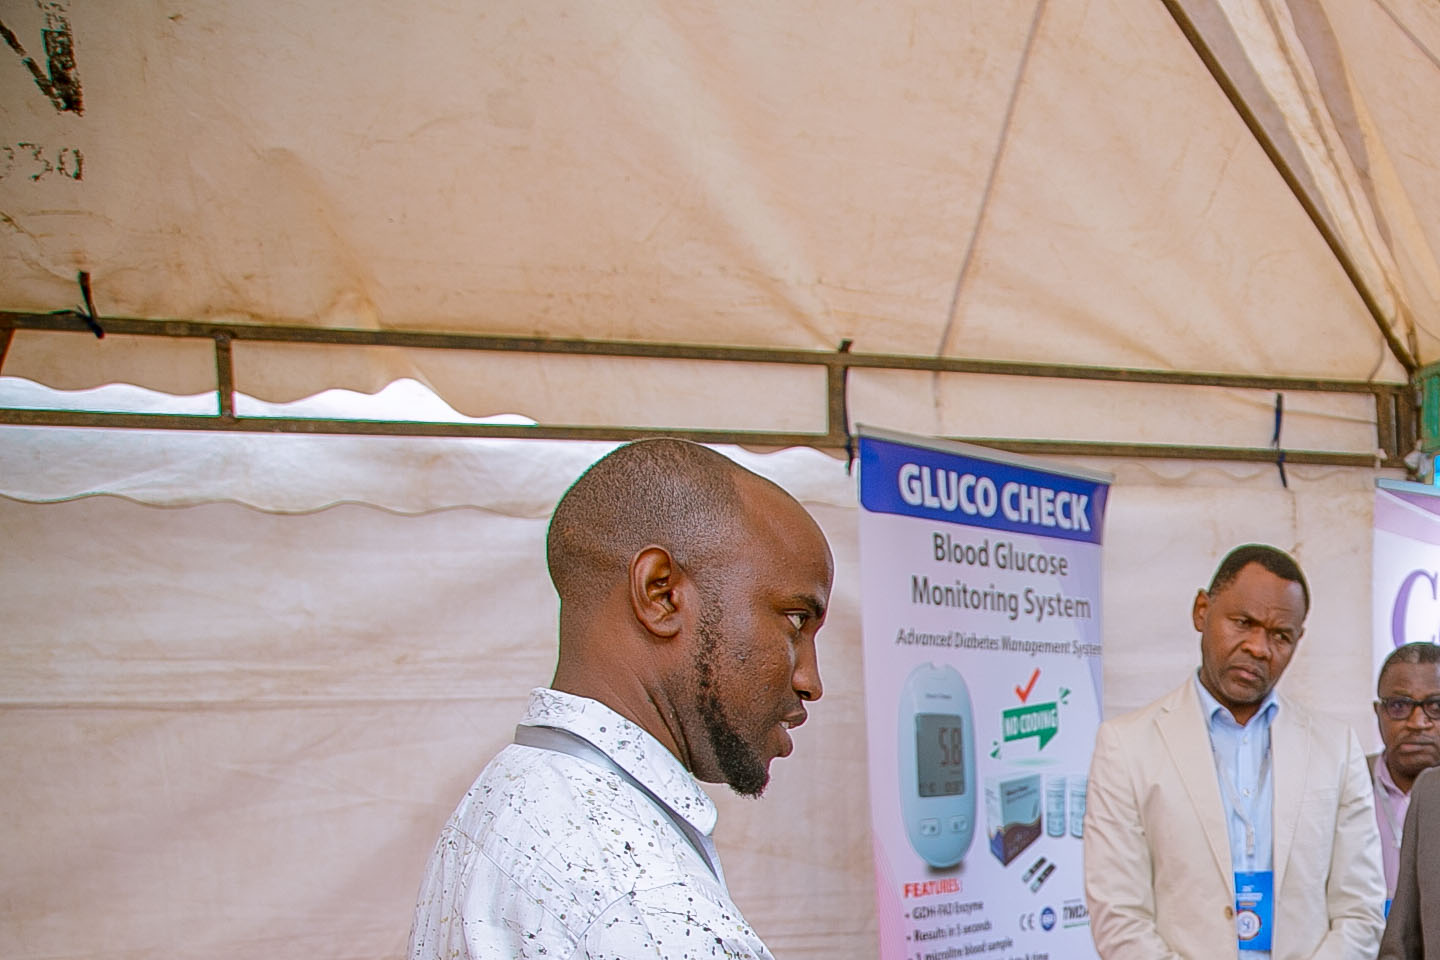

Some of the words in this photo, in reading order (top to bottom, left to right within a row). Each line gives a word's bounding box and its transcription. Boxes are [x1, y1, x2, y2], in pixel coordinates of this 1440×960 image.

[899, 463, 998, 517] GLUCO
[1001, 481, 1091, 532] CHECK
[932, 532, 990, 567] Blood
[994, 542, 1069, 576] Glucose
[911, 574, 1019, 620] Monitoring
[1023, 587, 1092, 622] System
[896, 628, 951, 648] Advanced
[954, 631, 1000, 650] Diabetes
[1001, 635, 1071, 656] Management
[904, 878, 960, 898] FEATURES
[1063, 904, 1089, 920] TMD
[914, 928, 947, 942] Results
[964, 943, 986, 956] blood
